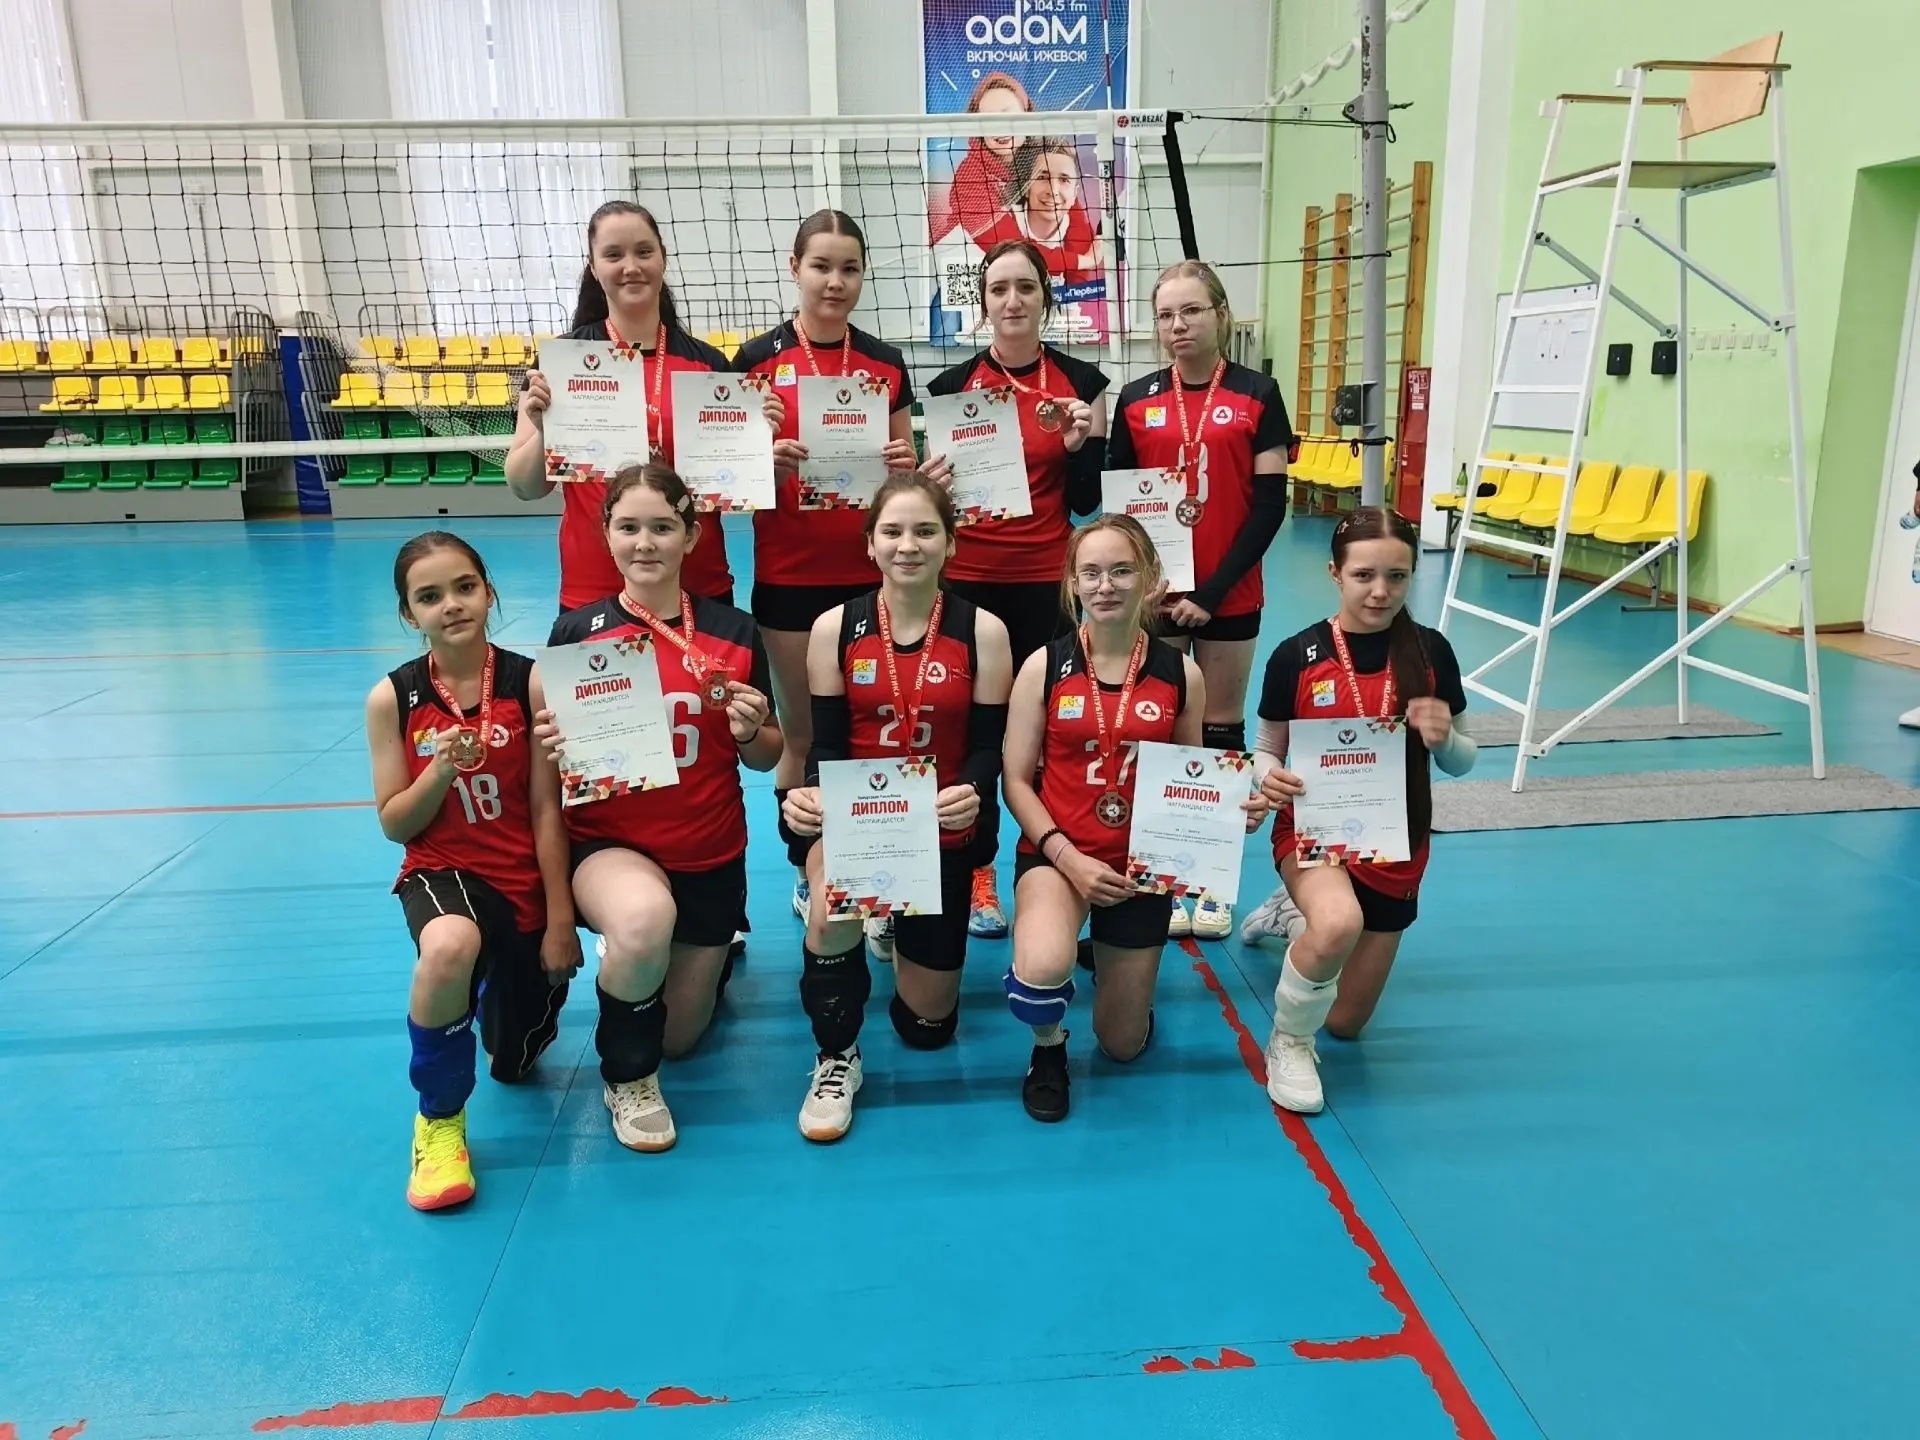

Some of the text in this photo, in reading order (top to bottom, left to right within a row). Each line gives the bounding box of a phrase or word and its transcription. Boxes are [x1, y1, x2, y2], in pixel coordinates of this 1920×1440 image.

[567, 379, 619, 393] ДИПЛОМ
[698, 410, 747, 424] ДИПЛОМ
[822, 413, 867, 425] ДИПЛОМ
[951, 423, 997, 442] ДИПЛОМ
[1125, 501, 1169, 515] ДИПЛОМ
[885, 643, 900, 697] РЕСПУБЛИКА
[481, 667, 491, 713] ТЕРРИТОРИЯ
[575, 677, 632, 700] ДИПЛОМ
[1091, 681, 1105, 734] РЕСПУБЛИКА
[661, 692, 701, 768] 6
[1085, 739, 1139, 786] 27
[1320, 752, 1376, 768] ДИПЛОМ
[452, 773, 502, 824] 18
[1163, 784, 1221, 804] ДИПЛОМ
[851, 800, 909, 817] ДИПЛОМ
